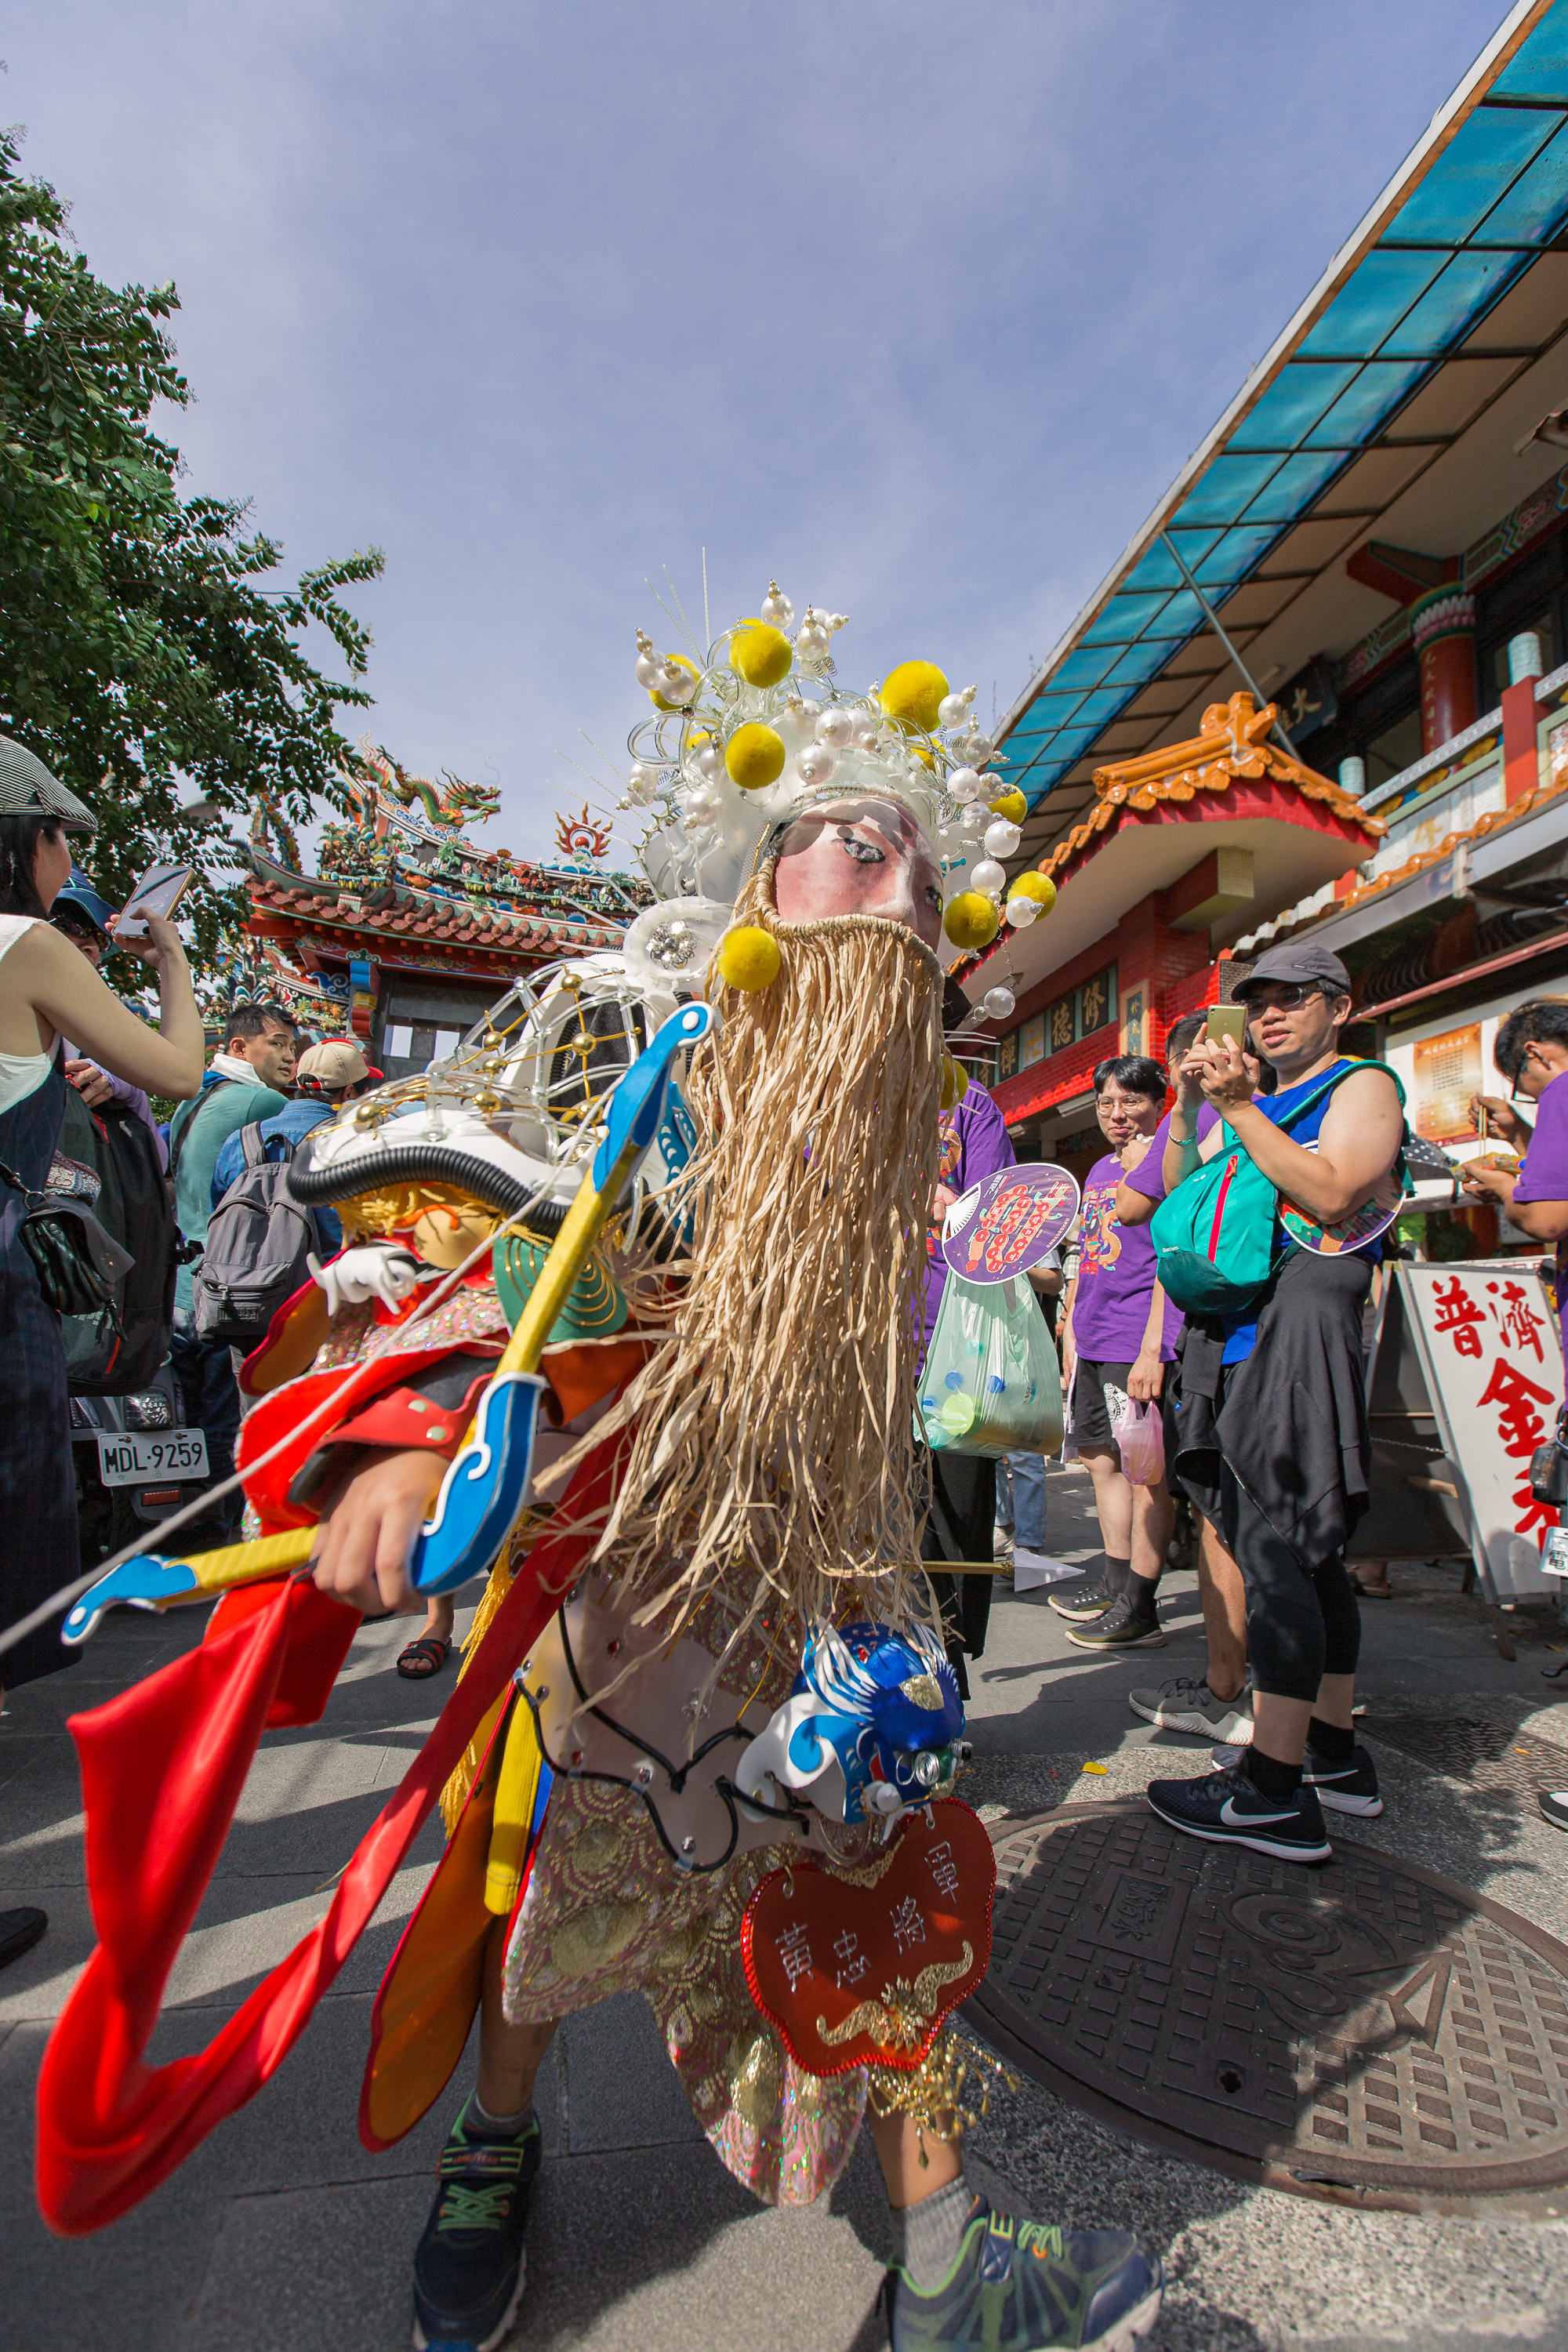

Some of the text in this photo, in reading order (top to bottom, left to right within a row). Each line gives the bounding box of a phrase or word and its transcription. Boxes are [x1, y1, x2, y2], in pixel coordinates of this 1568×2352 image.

[1432, 1275, 1546, 1363] 普濟
[775, 1840, 960, 1994] 黃忠將軍
